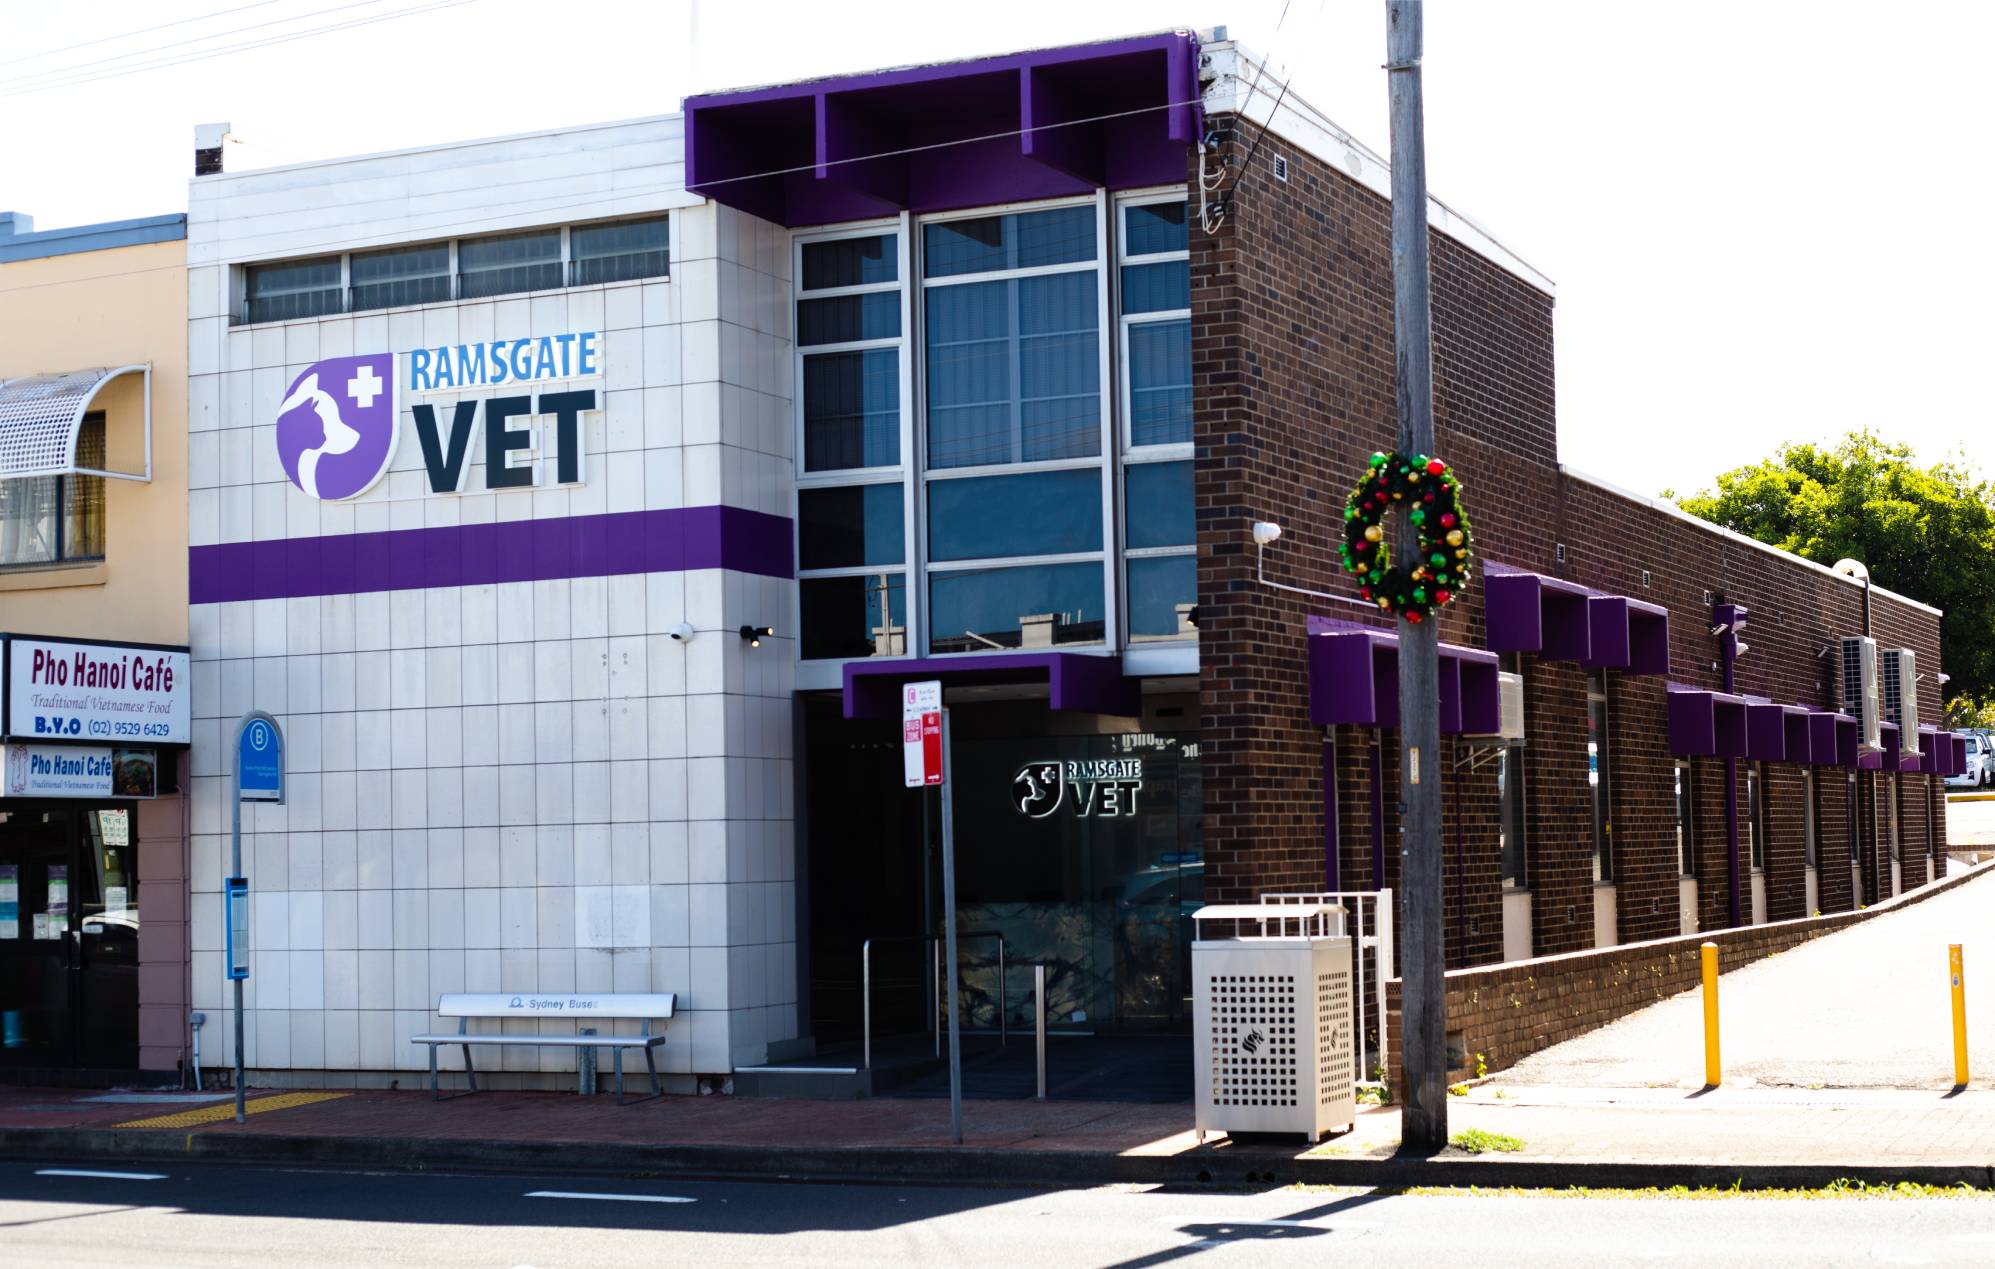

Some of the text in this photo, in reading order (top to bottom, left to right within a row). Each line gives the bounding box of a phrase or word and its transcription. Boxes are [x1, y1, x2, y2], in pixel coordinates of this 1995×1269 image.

[411, 332, 597, 390] RAMSGATE
[412, 390, 597, 493] VET
[32, 649, 173, 693] Pho Hanoi Café
[32, 694, 173, 714] Traditional Vietnamese Food
[34, 716, 169, 736] B.Y.O (02) 9529 6429
[31, 754, 112, 776] Pho Hanoi Café
[1066, 758, 1142, 779] RAMSGATE
[1068, 780, 1142, 817] VET
[529, 999, 564, 1010] Sydney
